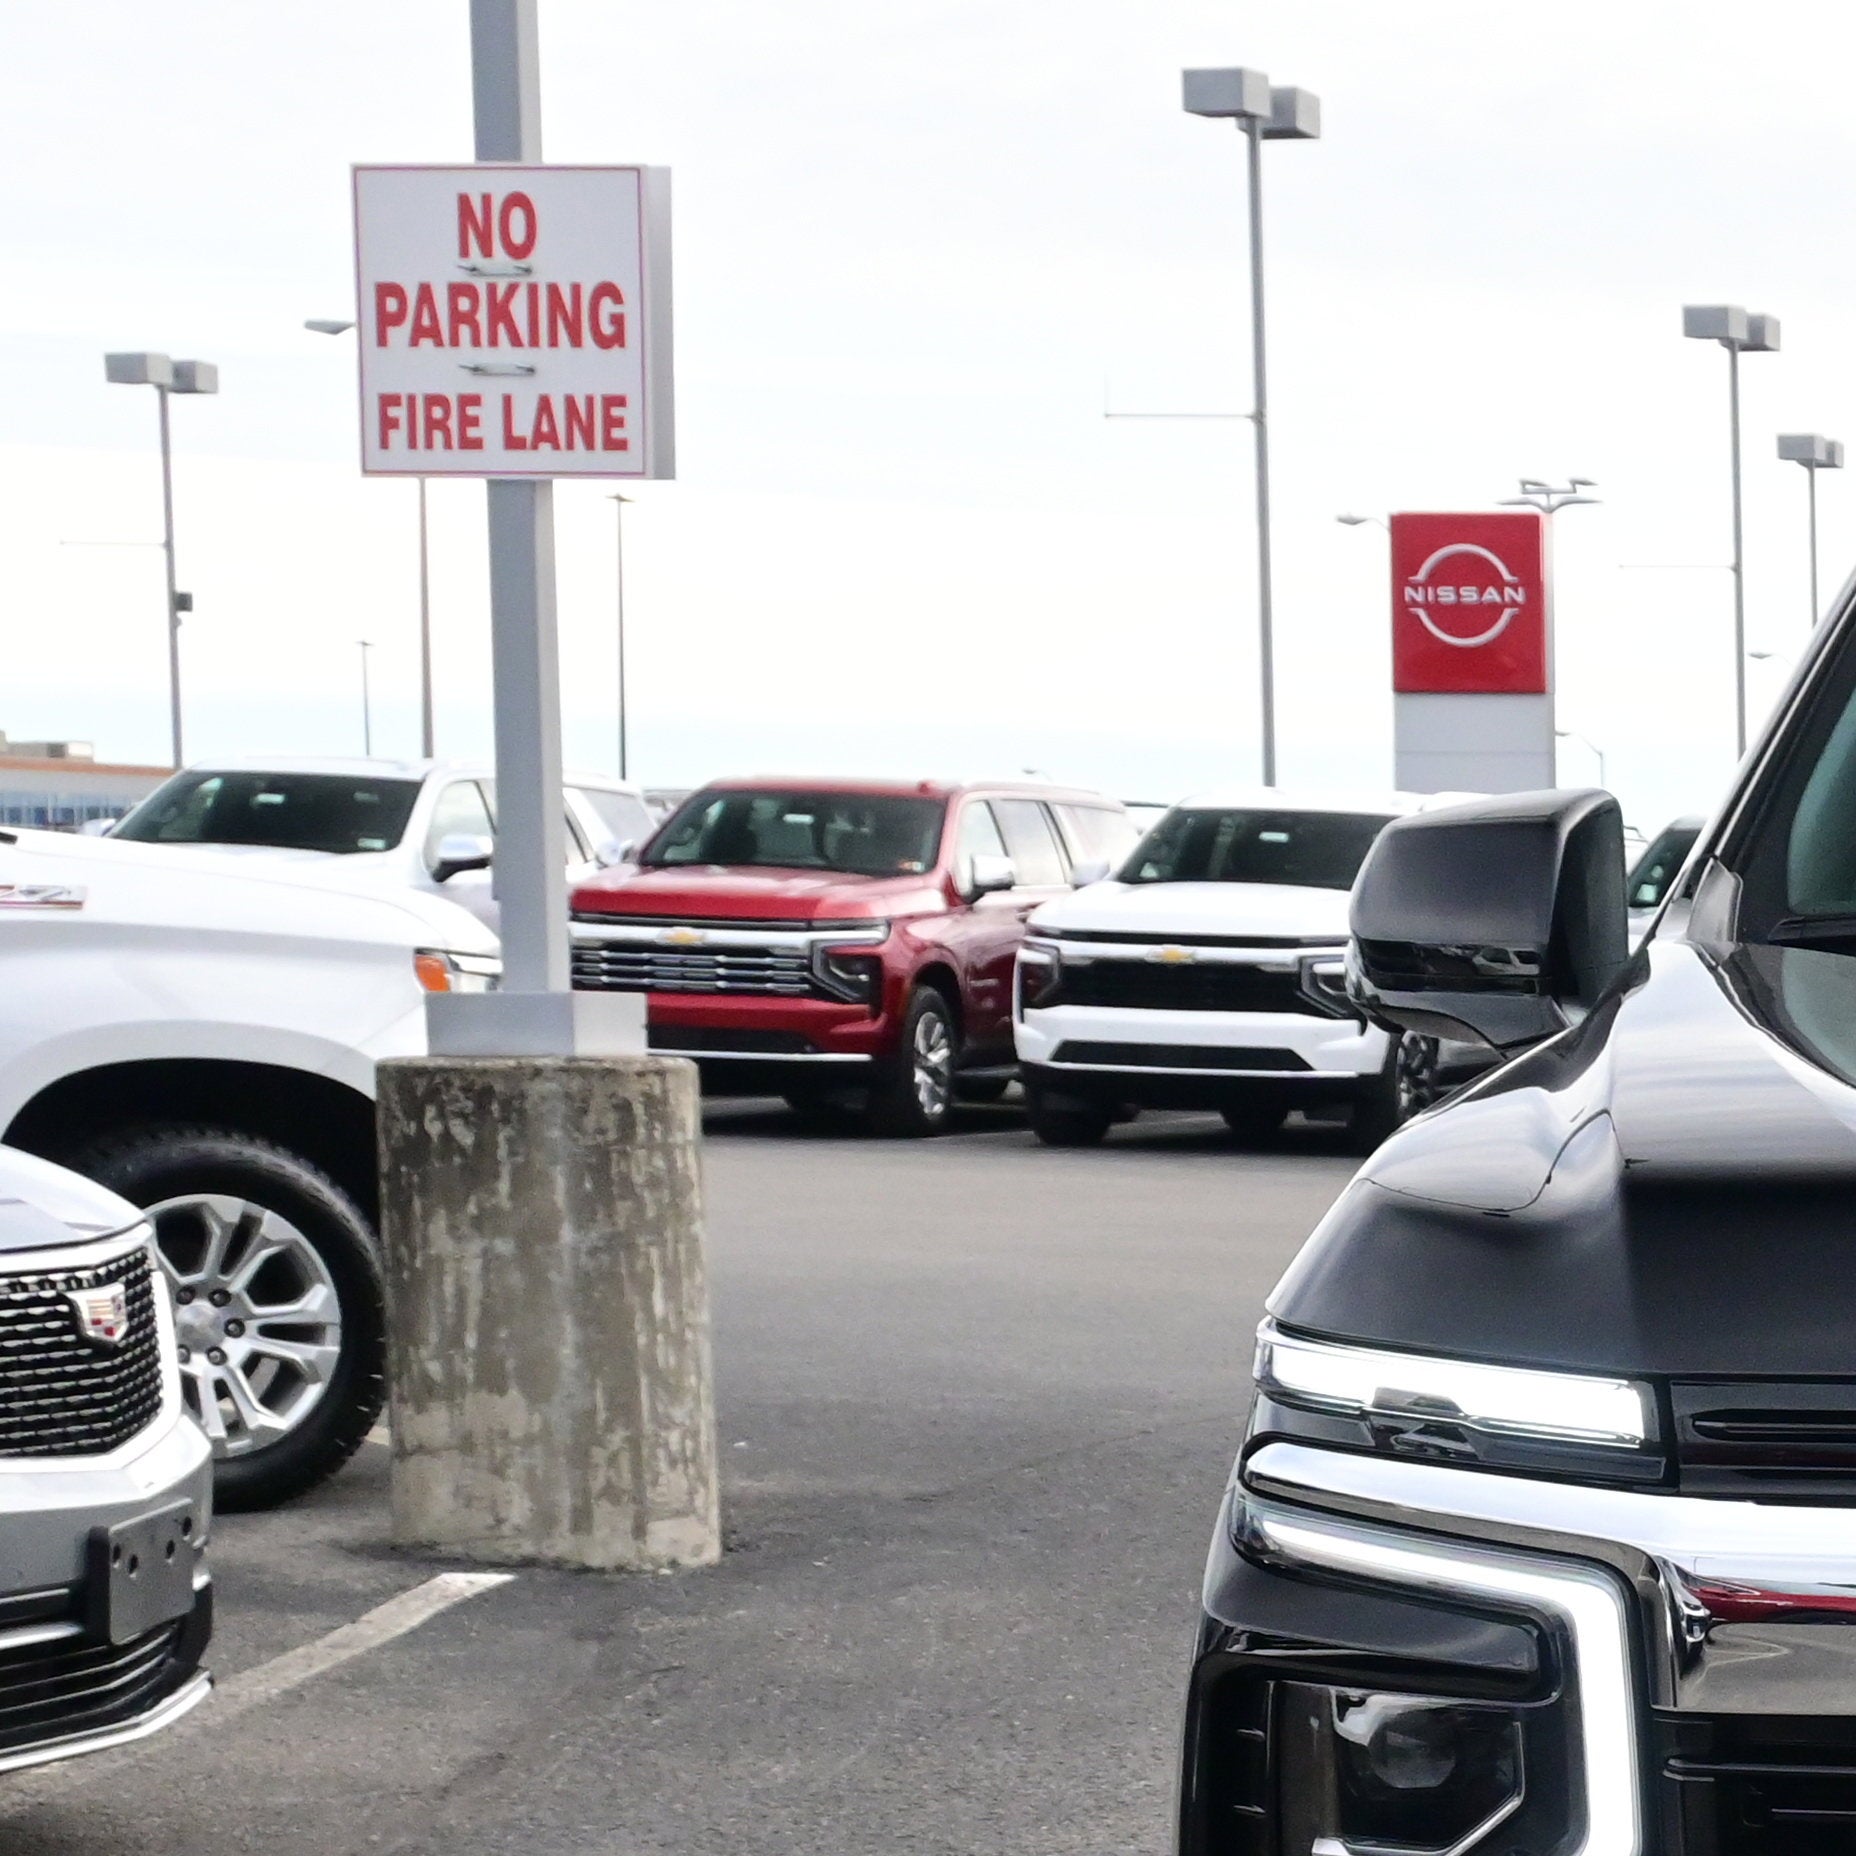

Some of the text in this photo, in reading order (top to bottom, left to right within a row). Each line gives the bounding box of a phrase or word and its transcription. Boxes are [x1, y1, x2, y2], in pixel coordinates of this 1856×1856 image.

[457, 191, 538, 259] NO
[375, 281, 626, 349] PARKING
[378, 394, 628, 451] FIRE LANE
[1404, 586, 1526, 604] NISSAN
